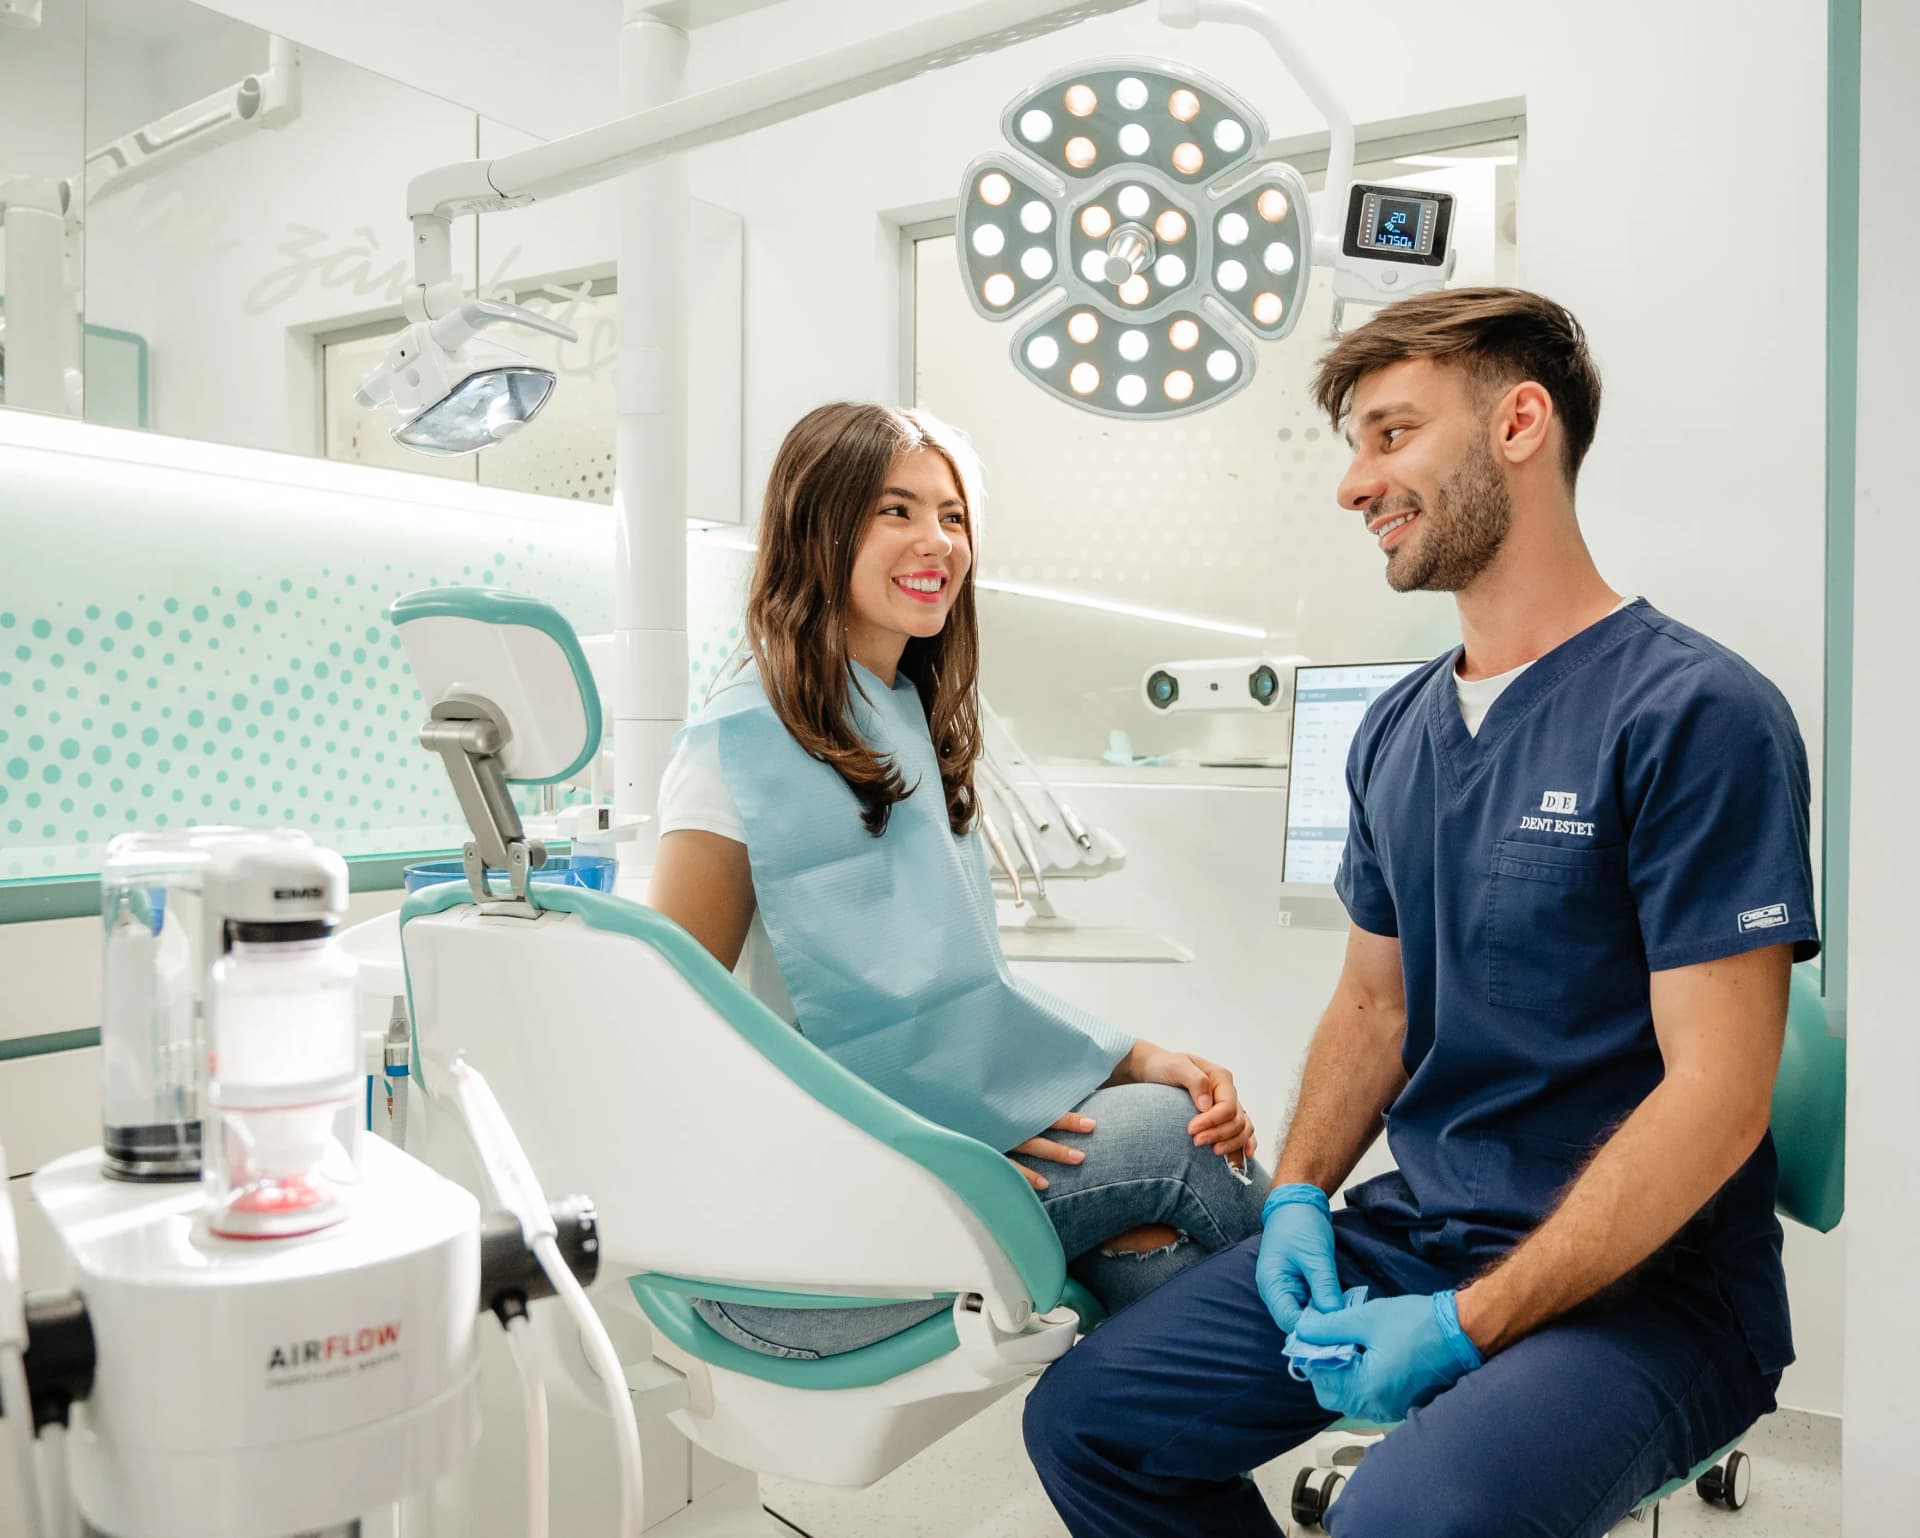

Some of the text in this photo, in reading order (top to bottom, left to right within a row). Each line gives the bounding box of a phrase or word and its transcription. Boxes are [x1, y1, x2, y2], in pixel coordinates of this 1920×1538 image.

[1390, 212, 1406, 224] 20
[1520, 816, 1595, 836] DENT ESTET
[266, 1319, 402, 1371] AIRFLOW
